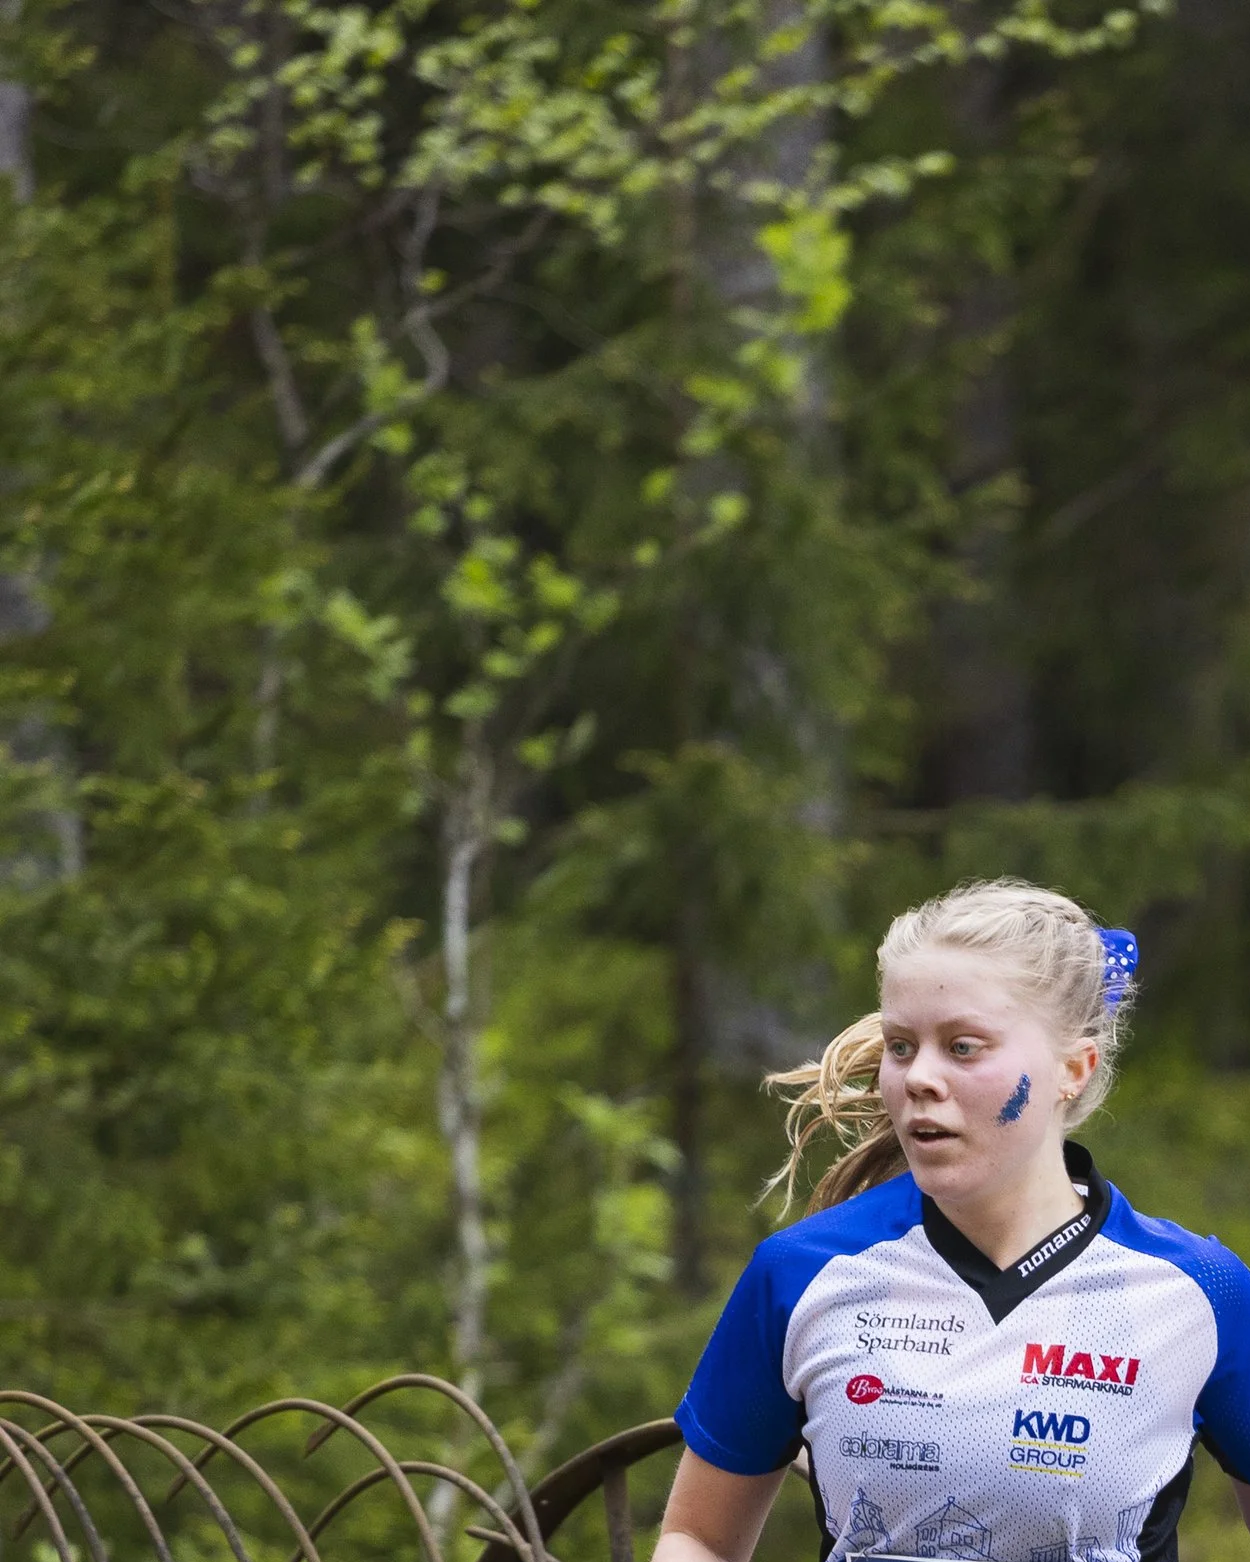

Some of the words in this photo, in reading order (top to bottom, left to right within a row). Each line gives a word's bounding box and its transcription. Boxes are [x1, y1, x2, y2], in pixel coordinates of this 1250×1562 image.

[1018, 1213, 1092, 1278] noname
[854, 1311, 966, 1334] Sörmlands
[856, 1332, 954, 1356] Sparbank
[1022, 1343, 1141, 1386] MAXI
[1020, 1375, 1039, 1385] ICA
[1041, 1375, 1134, 1397] STORMARKNAD
[1012, 1409, 1091, 1444] KWD
[840, 1431, 941, 1463] colorama
[1010, 1447, 1086, 1469] GROUP
